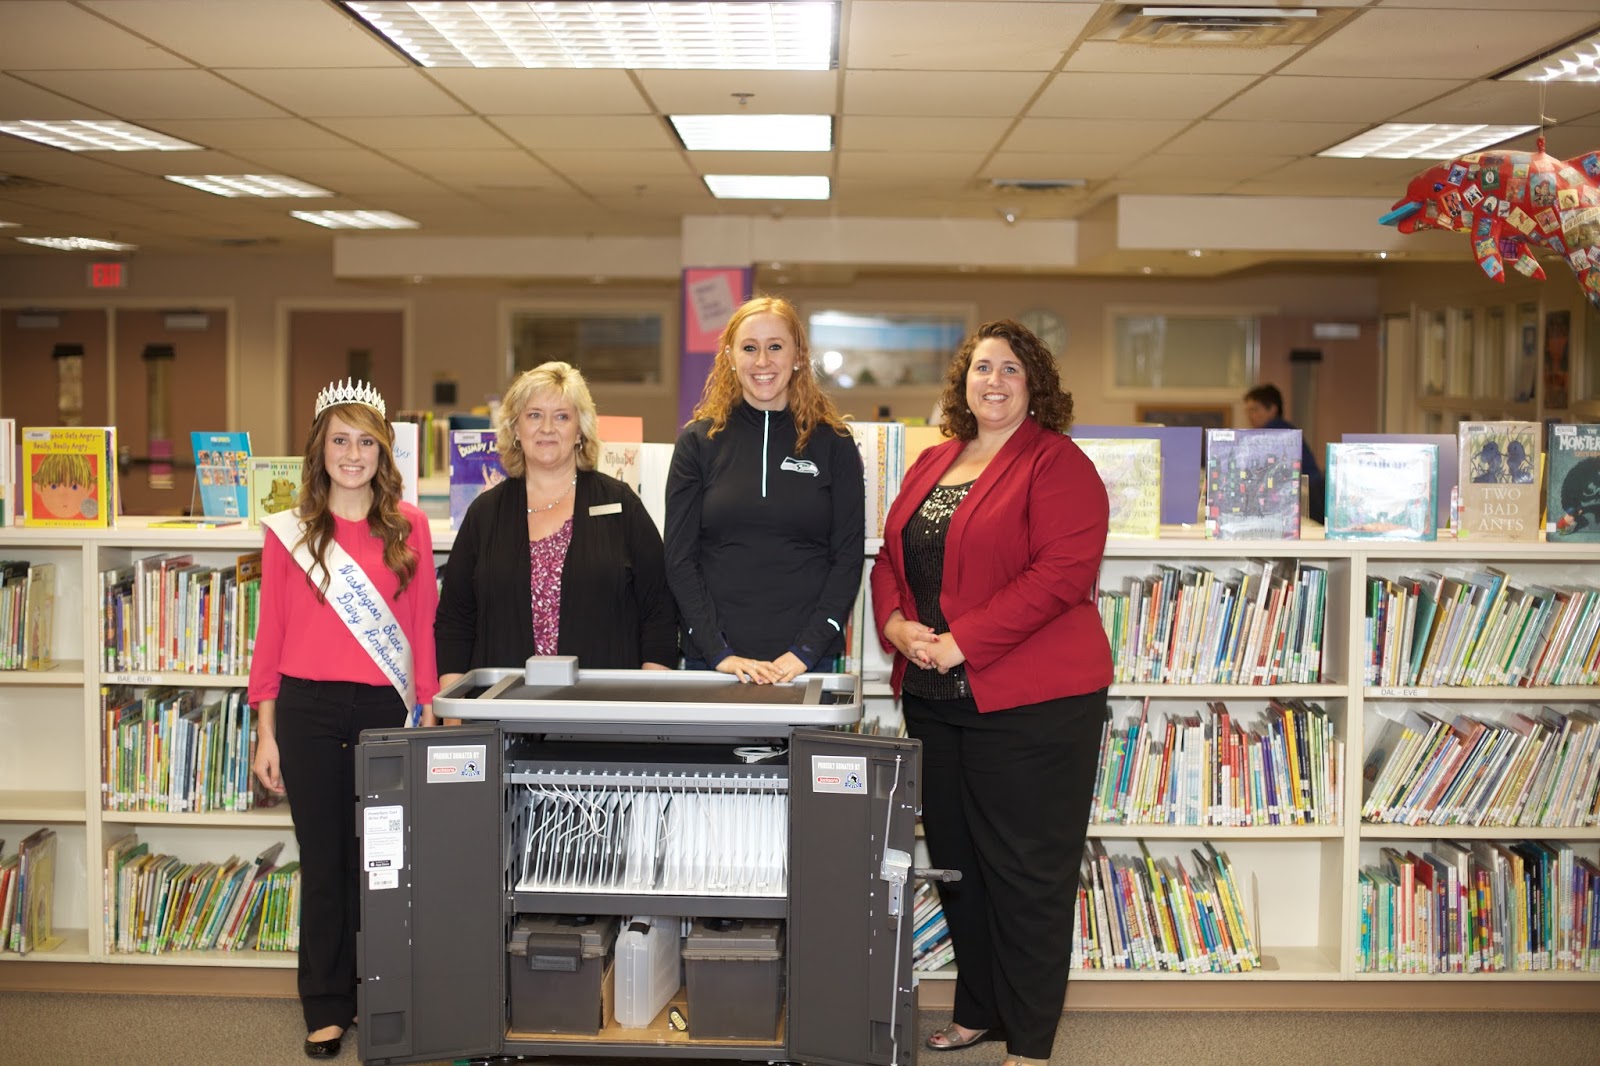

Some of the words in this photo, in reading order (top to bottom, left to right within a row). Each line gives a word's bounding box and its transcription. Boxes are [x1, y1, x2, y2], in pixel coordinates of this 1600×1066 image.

[93, 263, 121, 288] EXIT
[1481, 487, 1522, 500] TWO
[1483, 503, 1519, 515] BAD
[1477, 519, 1524, 531] ANTS
[338, 564, 382, 621] Washington
[383, 623, 403, 654] State
[336, 592, 362, 625] Dairy
[364, 629, 409, 691] Ambassador
[433, 752, 452, 760] PROUDLY
[473, 751, 480, 759] BY
